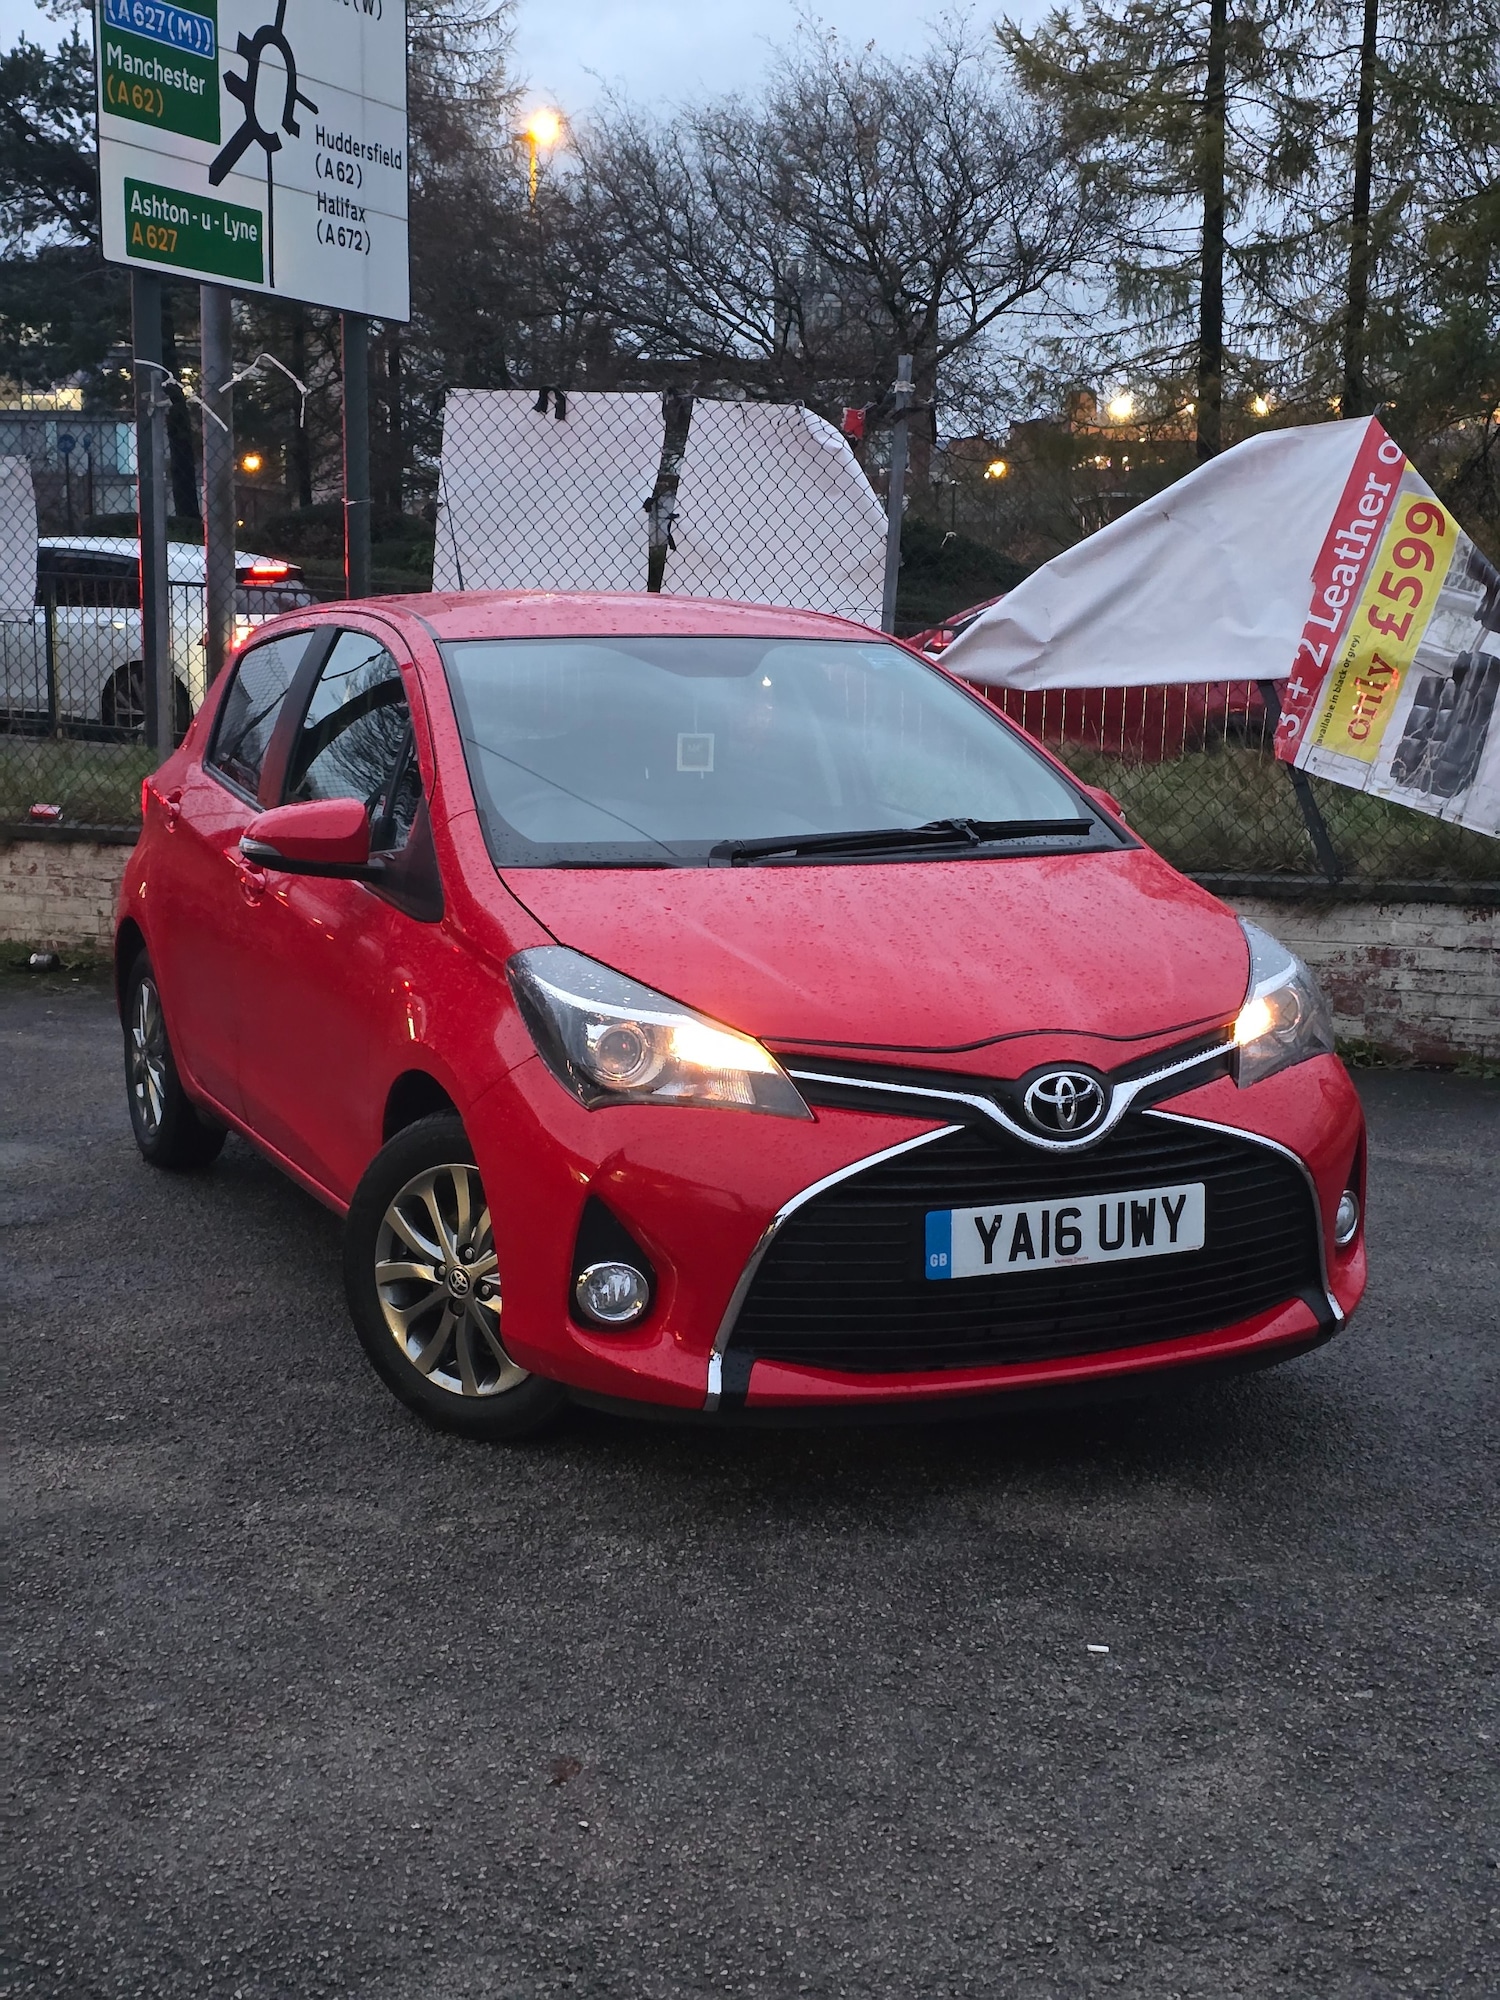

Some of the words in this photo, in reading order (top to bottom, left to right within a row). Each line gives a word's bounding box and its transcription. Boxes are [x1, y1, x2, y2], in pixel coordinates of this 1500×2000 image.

[106, 41, 205, 96] Manchester
[107, 74, 164, 118] (A62)
[315, 124, 402, 170] Huddersfield
[315, 152, 363, 189] (A62)
[317, 190, 366, 223] Halifax
[132, 221, 178, 253] A627
[316, 218, 371, 256] (A672)
[1378, 431, 1403, 465] o
[1306, 471, 1392, 633] Leather
[1367, 502, 1446, 642] £599
[1295, 636, 1329, 667] 2
[1348, 634, 1361, 658] grey)
[1343, 658, 1352, 668] or
[1287, 676, 1309, 699] +
[1333, 668, 1348, 693] black
[1330, 694, 1339, 704] in
[1277, 712, 1301, 738] 3
[974, 1207, 1083, 1264] YA16
[1099, 1194, 1187, 1251] UWY
[929, 1252, 948, 1268] GB
